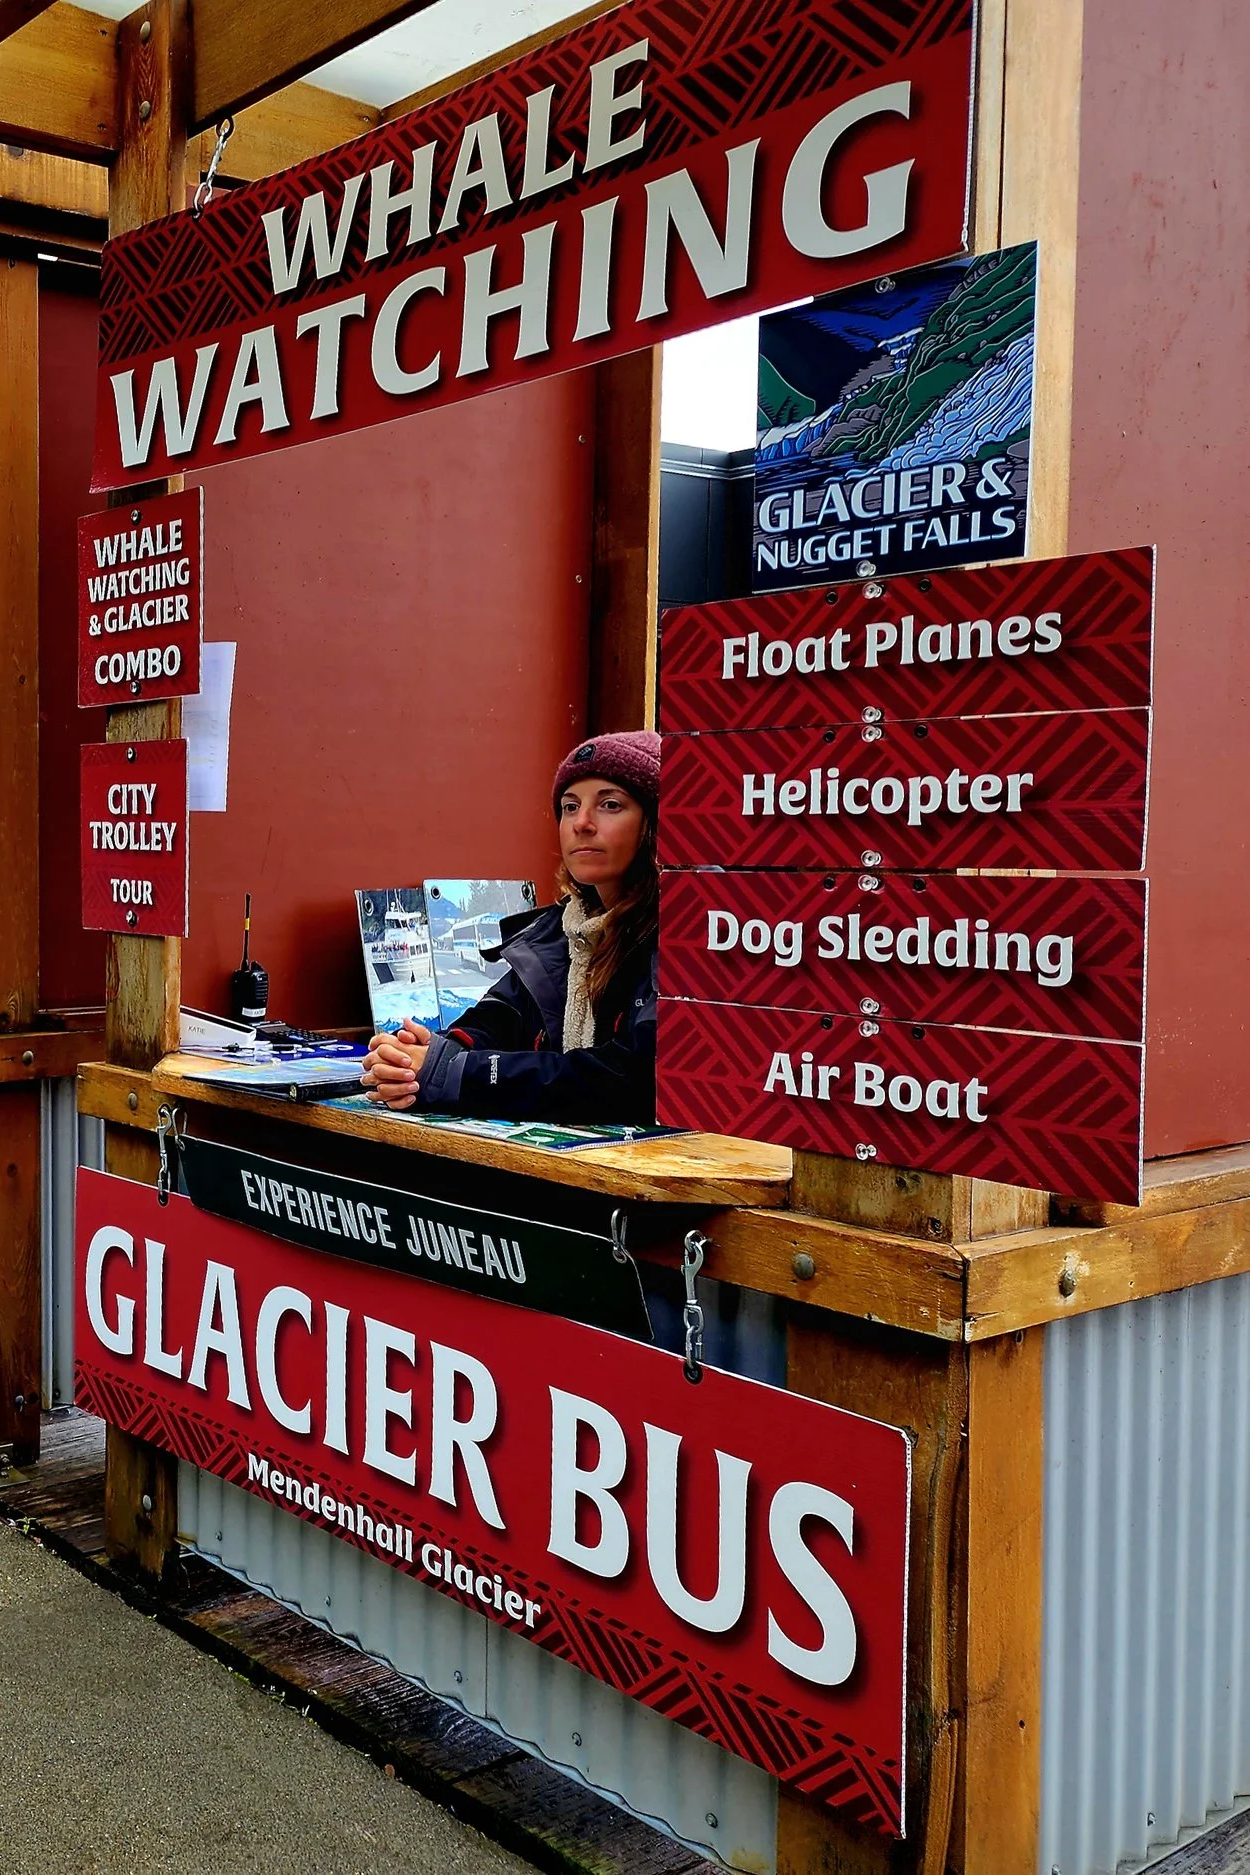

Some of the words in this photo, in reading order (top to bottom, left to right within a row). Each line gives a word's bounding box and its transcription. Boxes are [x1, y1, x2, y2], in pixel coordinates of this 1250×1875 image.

[261, 38, 649, 295] WHALE
[110, 80, 916, 467] WATCHING
[759, 461, 966, 533] GLACIER
[976, 457, 1013, 499] &
[93, 518, 183, 570] WHALE
[757, 524, 896, 572] NUGGET
[903, 505, 1015, 551] FALLS
[87, 557, 190, 603] WATCHING
[88, 615, 101, 636] &
[104, 594, 189, 632] GLACIER
[721, 628, 851, 680] Float
[864, 612, 1063, 668] Planes
[94, 644, 181, 685] COMBO
[107, 783, 157, 815] CITY
[742, 767, 1034, 826] Helicopter
[89, 821, 177, 853] TROLLEY
[110, 878, 153, 906] TOUR
[707, 910, 804, 968] Dog
[818, 913, 1074, 987] Sledding
[763, 1051, 840, 1101] Air
[853, 1061, 988, 1123] Boat
[240, 1169, 396, 1249] EXPERIENCE
[406, 1215, 527, 1284] JUNEAU
[85, 1225, 506, 1530] GLACIER
[547, 1385, 856, 1686] BUS
[247, 1451, 413, 1563] Mendenhall
[421, 1541, 542, 1629] Glacier
